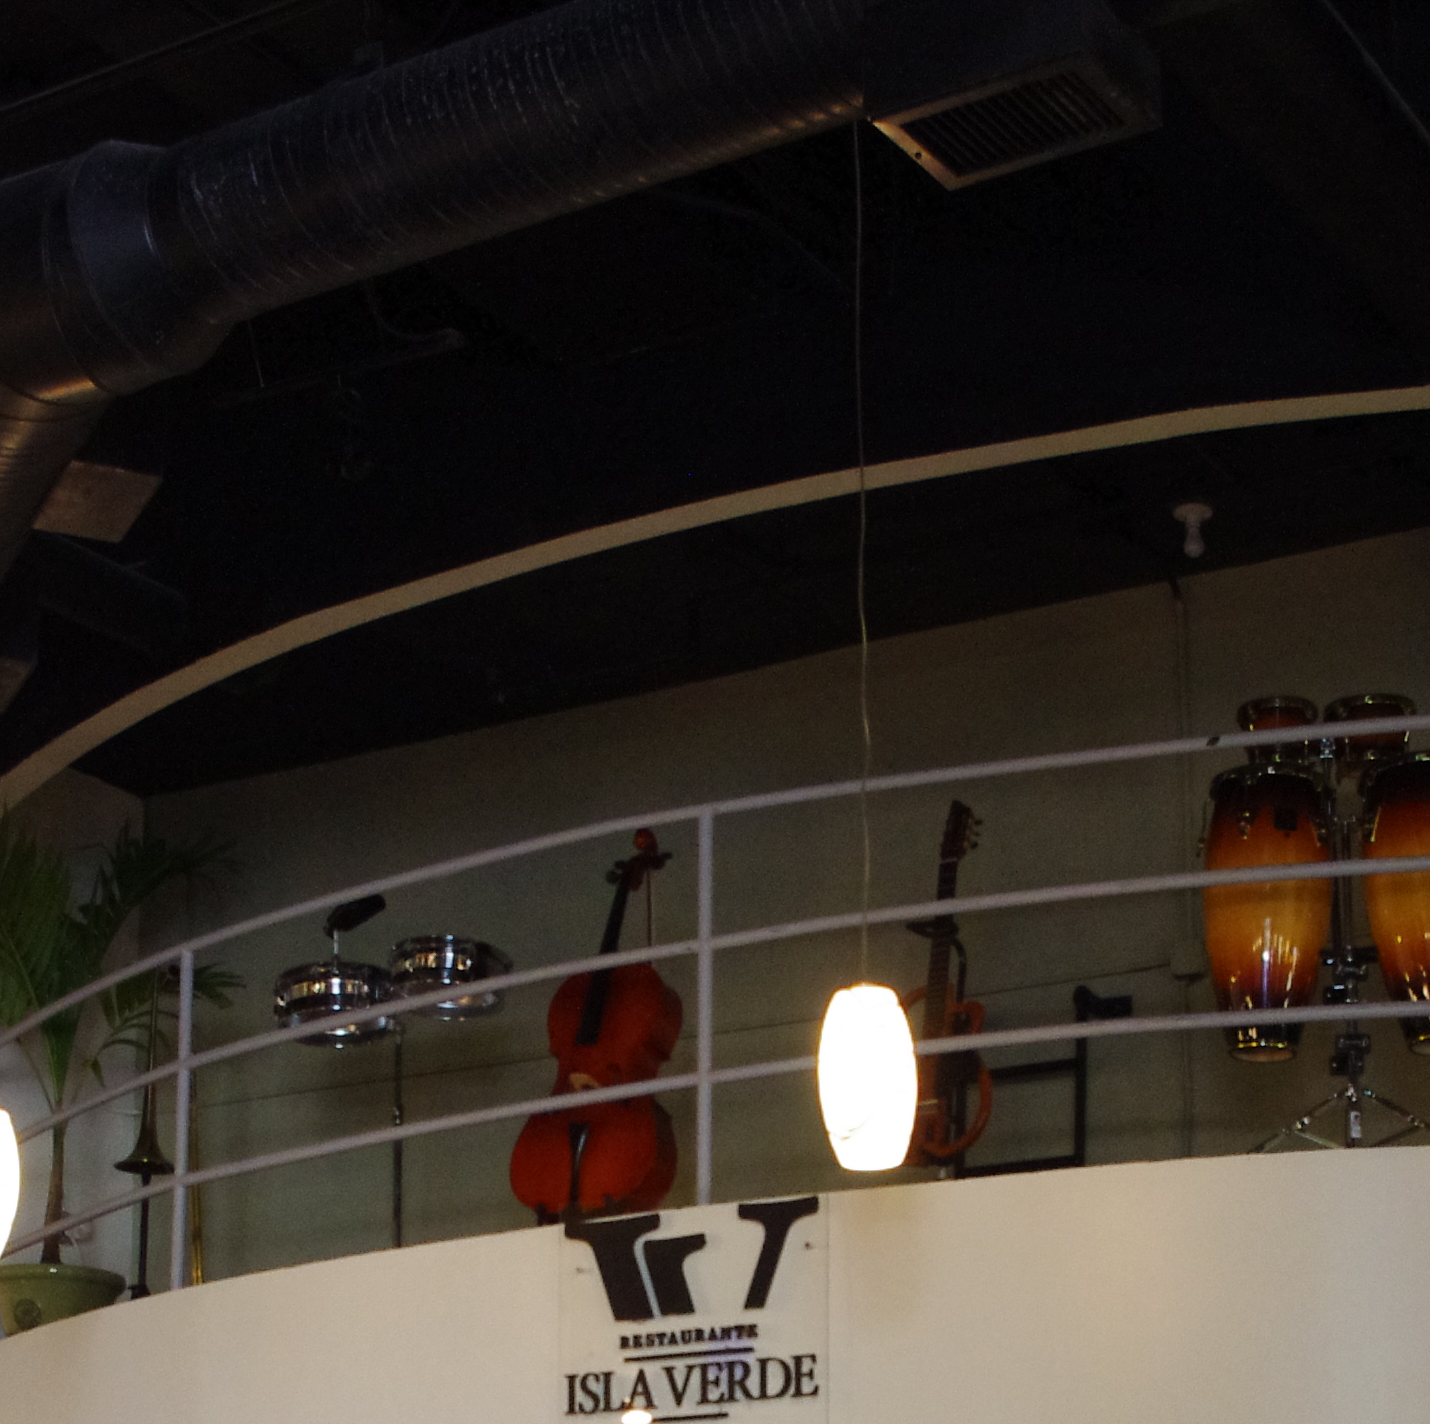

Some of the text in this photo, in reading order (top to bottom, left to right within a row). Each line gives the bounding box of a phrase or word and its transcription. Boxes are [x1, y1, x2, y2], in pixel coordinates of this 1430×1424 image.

[619, 1323, 759, 1350] RESTAURANTE
[565, 1353, 819, 1416] ISLA VERDE
